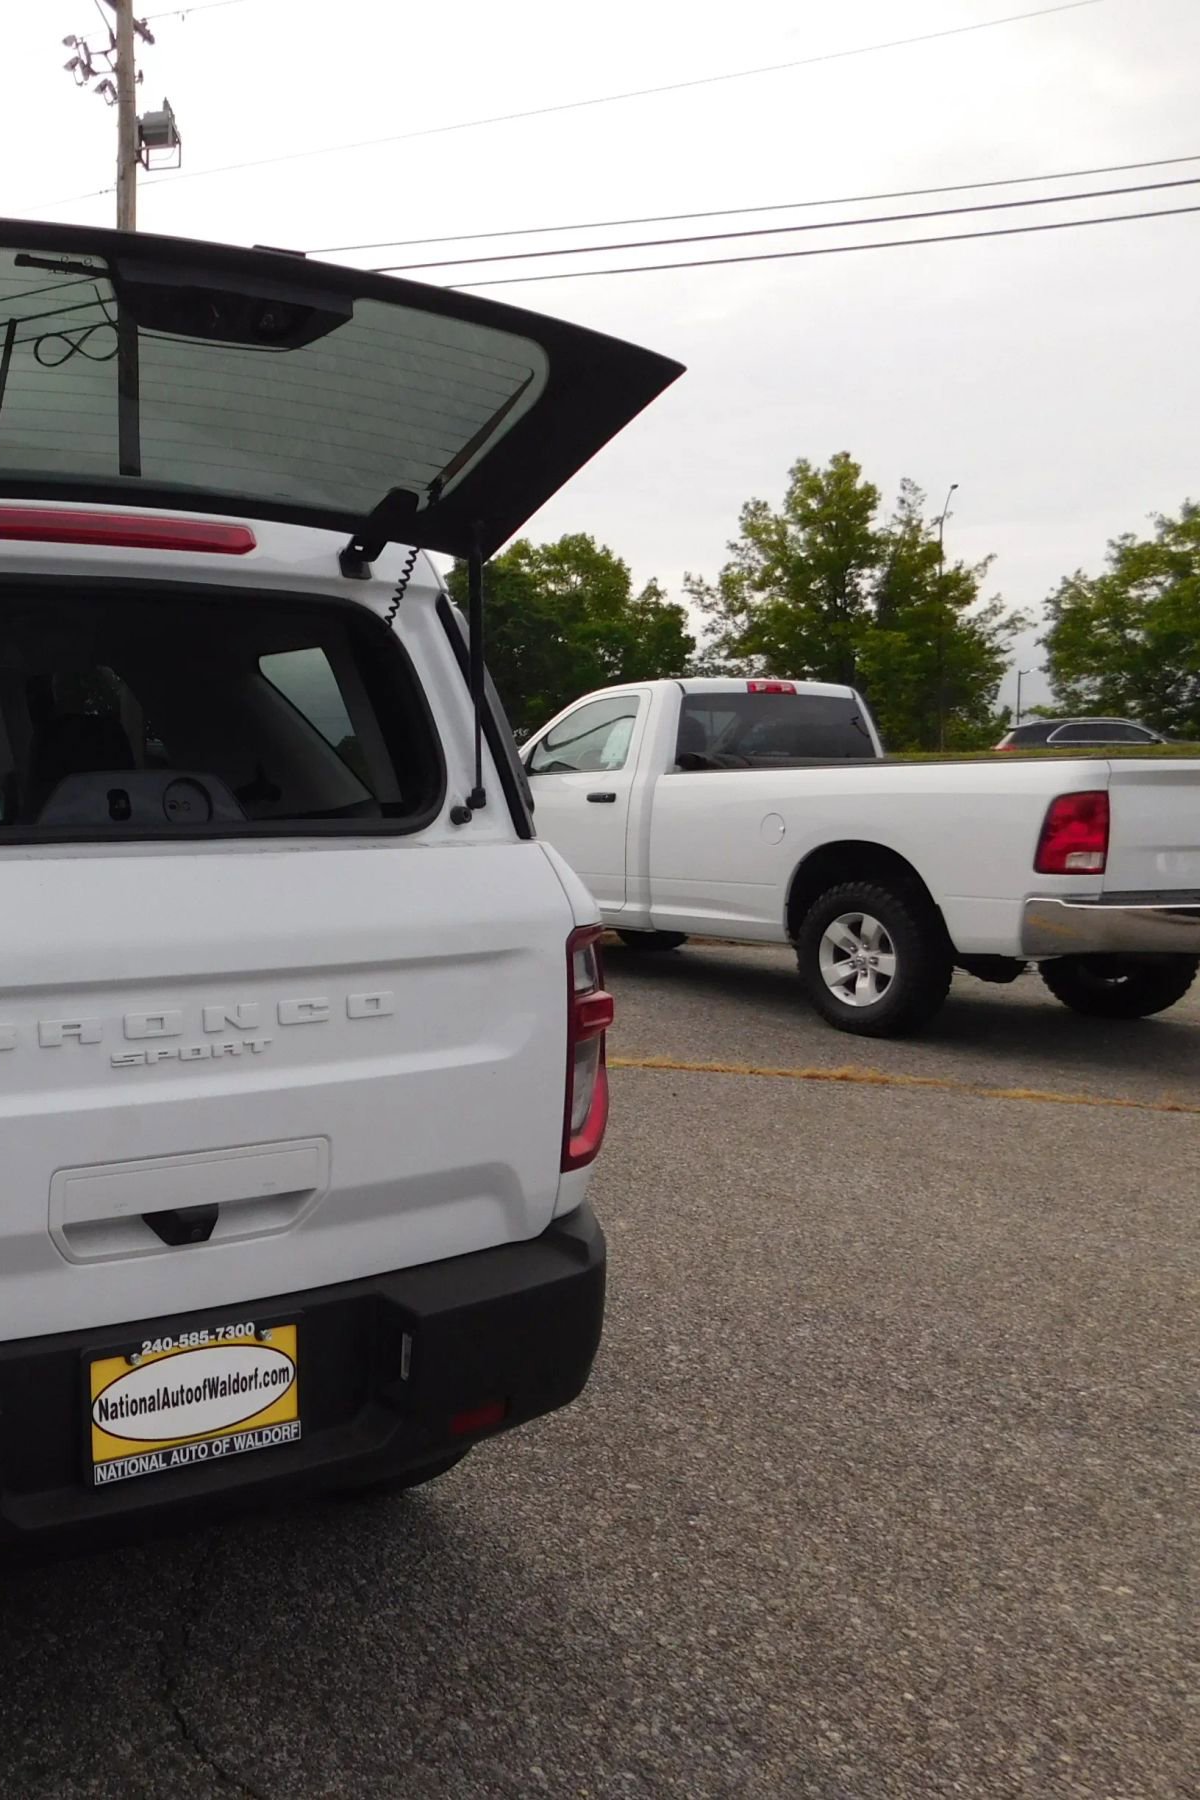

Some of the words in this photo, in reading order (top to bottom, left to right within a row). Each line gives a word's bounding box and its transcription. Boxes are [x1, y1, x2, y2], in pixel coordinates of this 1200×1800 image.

[110, 1037, 273, 1068] SPORT
[141, 1321, 256, 1355] 240-585-7300
[98, 1366, 290, 1423] NationalAutoofWaldorf.com
[96, 1452, 167, 1482] NATIONAL
[170, 1443, 208, 1465] AUTO
[211, 1438, 231, 1457] OF
[233, 1423, 299, 1450] WALDORF
